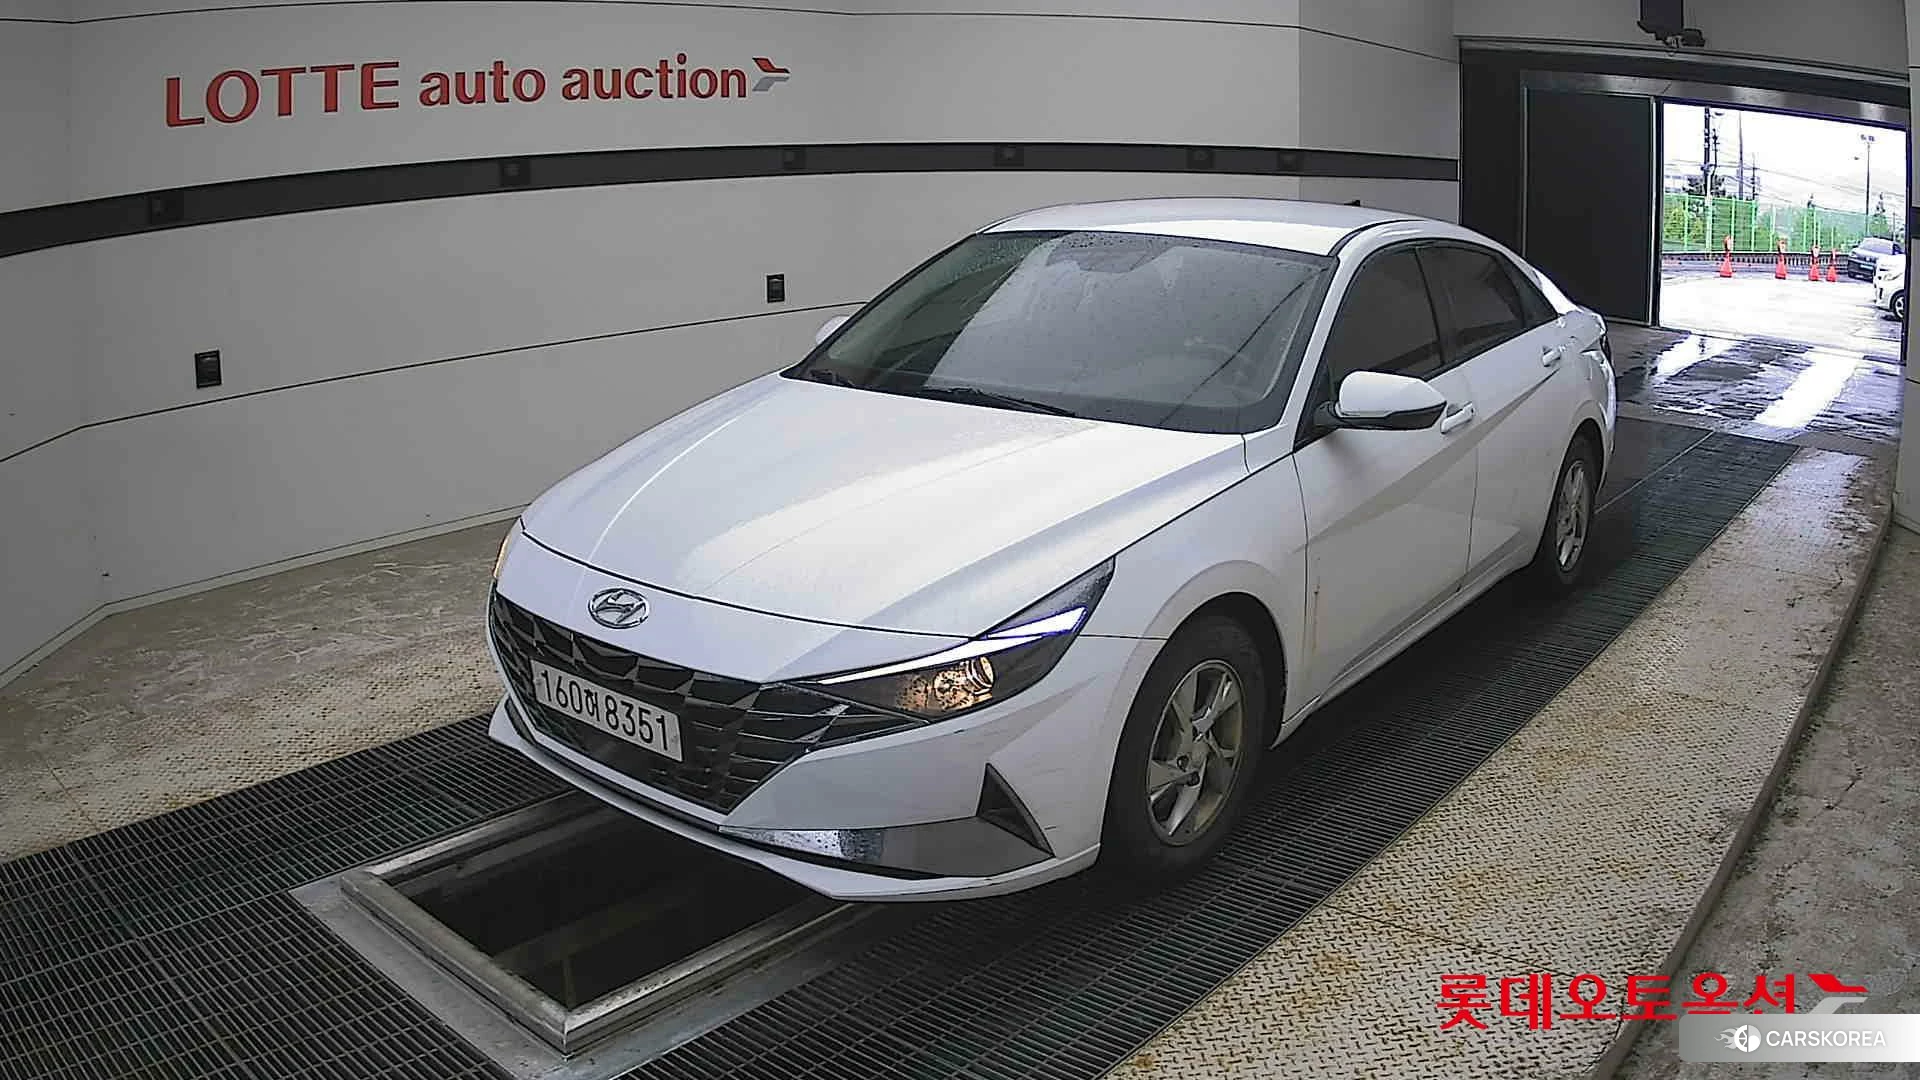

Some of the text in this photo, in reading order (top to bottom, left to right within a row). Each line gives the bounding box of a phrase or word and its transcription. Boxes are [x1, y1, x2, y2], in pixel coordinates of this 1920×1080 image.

[165, 53, 749, 127] LOTTE auto auction
